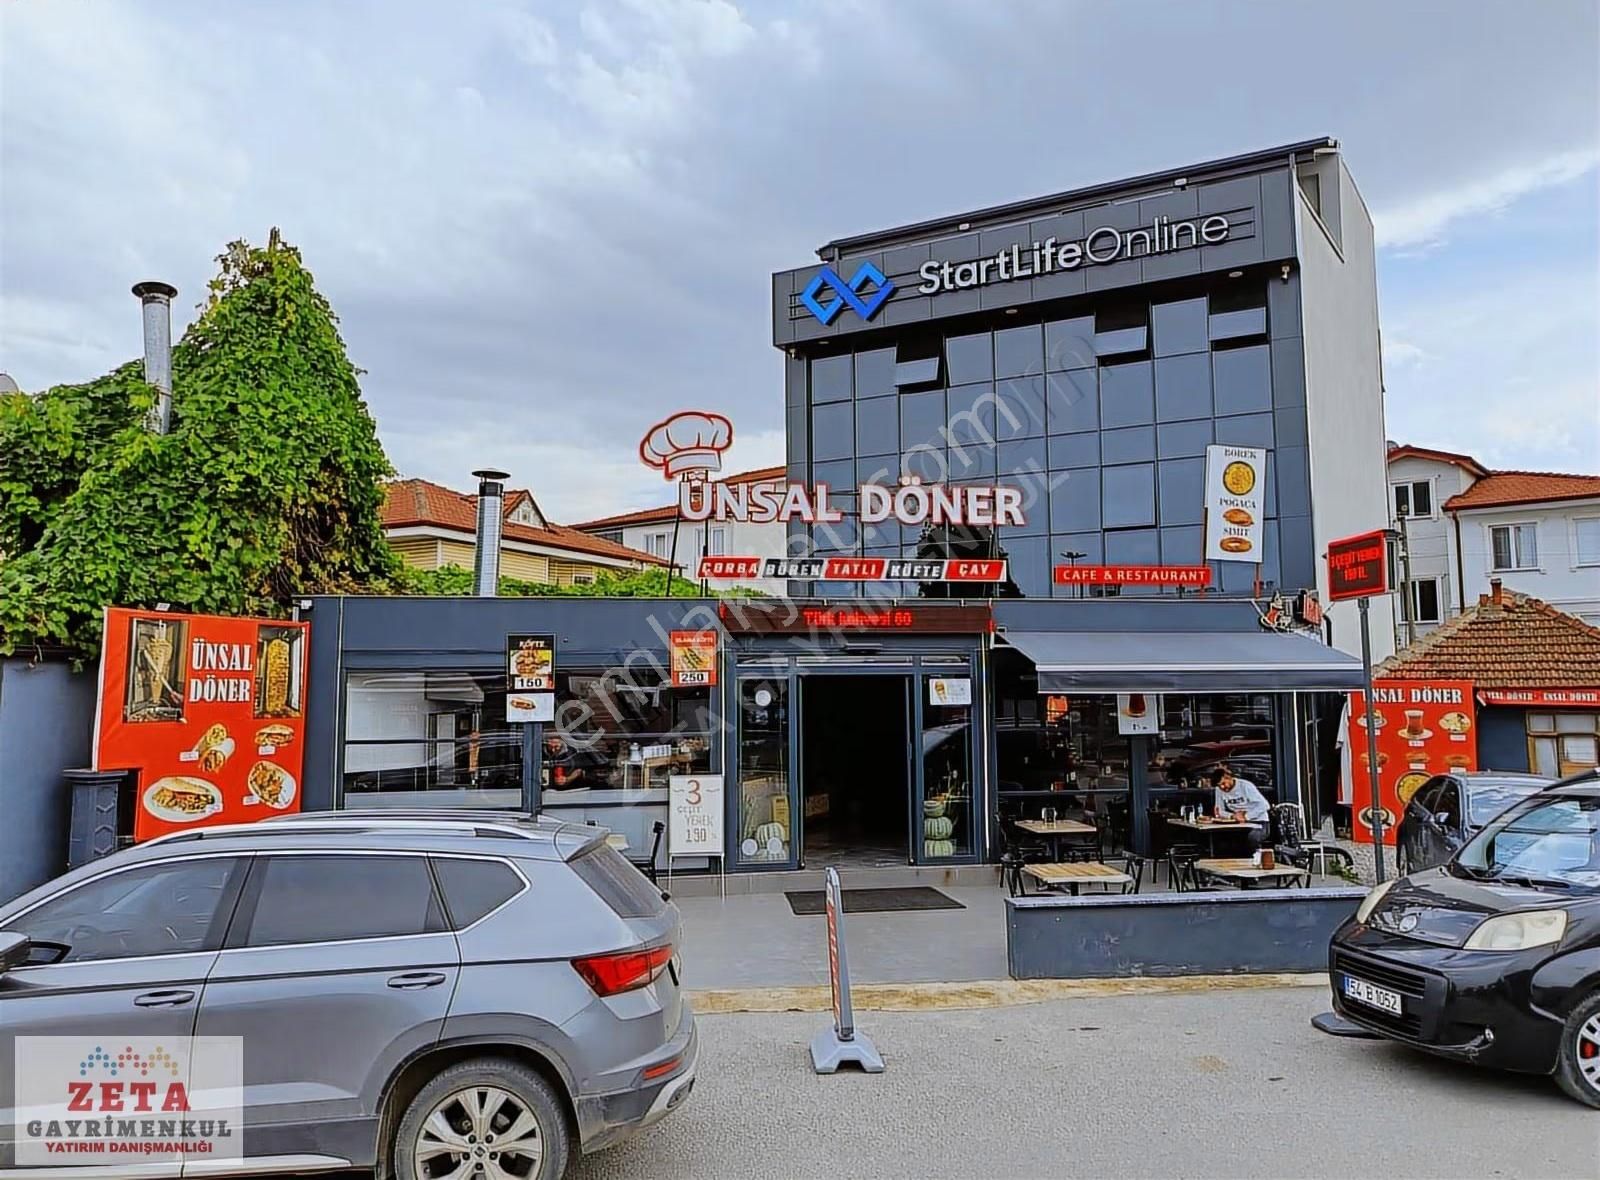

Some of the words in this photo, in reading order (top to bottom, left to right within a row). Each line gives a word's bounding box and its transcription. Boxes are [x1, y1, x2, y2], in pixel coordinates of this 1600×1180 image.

[918, 214, 1230, 297] StartLifeOnline
[859, 475, 1026, 526] DÖNER
[701, 561, 759, 577] ÇORBA
[765, 559, 821, 577] BÖREK
[832, 562, 878, 576] TATLI
[890, 559, 942, 578] KÖFTE
[959, 562, 990, 577] ÇAY
[1063, 570, 1097, 581] CAFE
[1103, 570, 1113, 581] &
[1117, 570, 1205, 581] RESTAURANT
[803, 611, 835, 626] Türk
[192, 637, 253, 671] ÜNSAL
[189, 674, 251, 703] DÖNER
[681, 673, 704, 682] 250
[1363, 688, 1406, 703] NSAL
[1411, 686, 1463, 704] DÖNER
[686, 779, 702, 805] 3
[1349, 980, 1362, 996] 54
[1366, 985, 1373, 1001] B
[1375, 989, 1398, 1011] 1052
